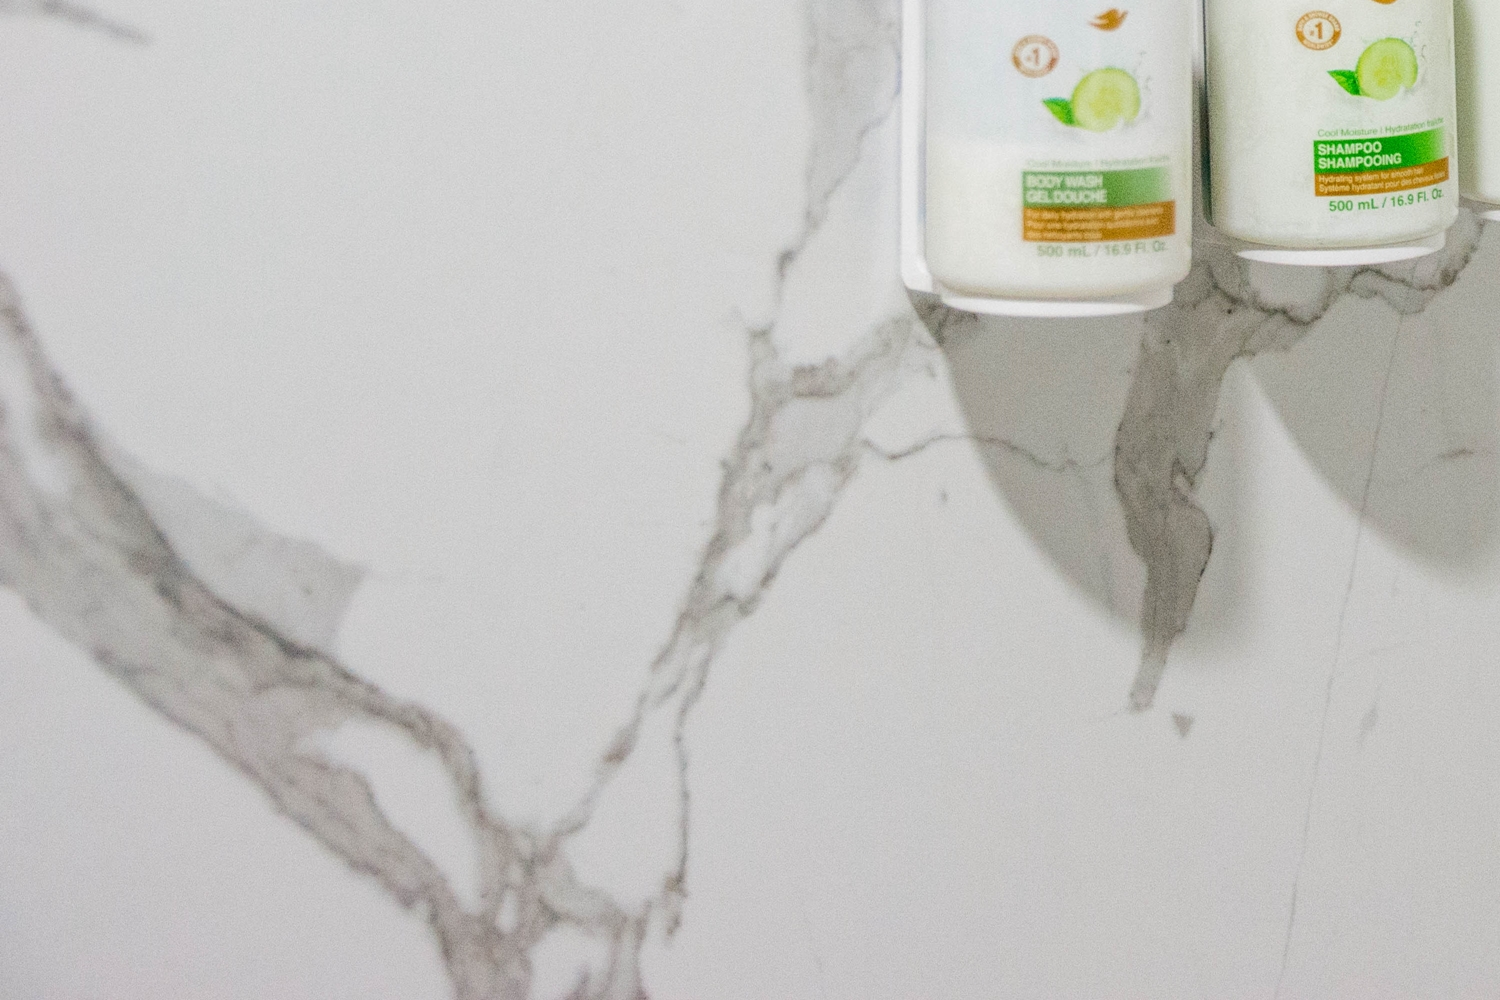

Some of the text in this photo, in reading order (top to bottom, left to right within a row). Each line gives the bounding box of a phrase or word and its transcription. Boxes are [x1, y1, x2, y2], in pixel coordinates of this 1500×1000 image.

[1317, 129, 1338, 138] Cool
[1341, 127, 1378, 137] Moisture
[1317, 141, 1382, 156] SHAMPOO
[1318, 153, 1402, 169] SHAMPOOING
[1026, 175, 1103, 188] BODY WASH
[1053, 189, 1107, 203] DOUCHE
[1329, 200, 1353, 212] 500
[1358, 198, 1378, 211] mL
[1390, 194, 1414, 207] 16.9
[1037, 245, 1063, 257] 500
[1067, 245, 1091, 257] mL
[1105, 244, 1131, 256] 16.9
